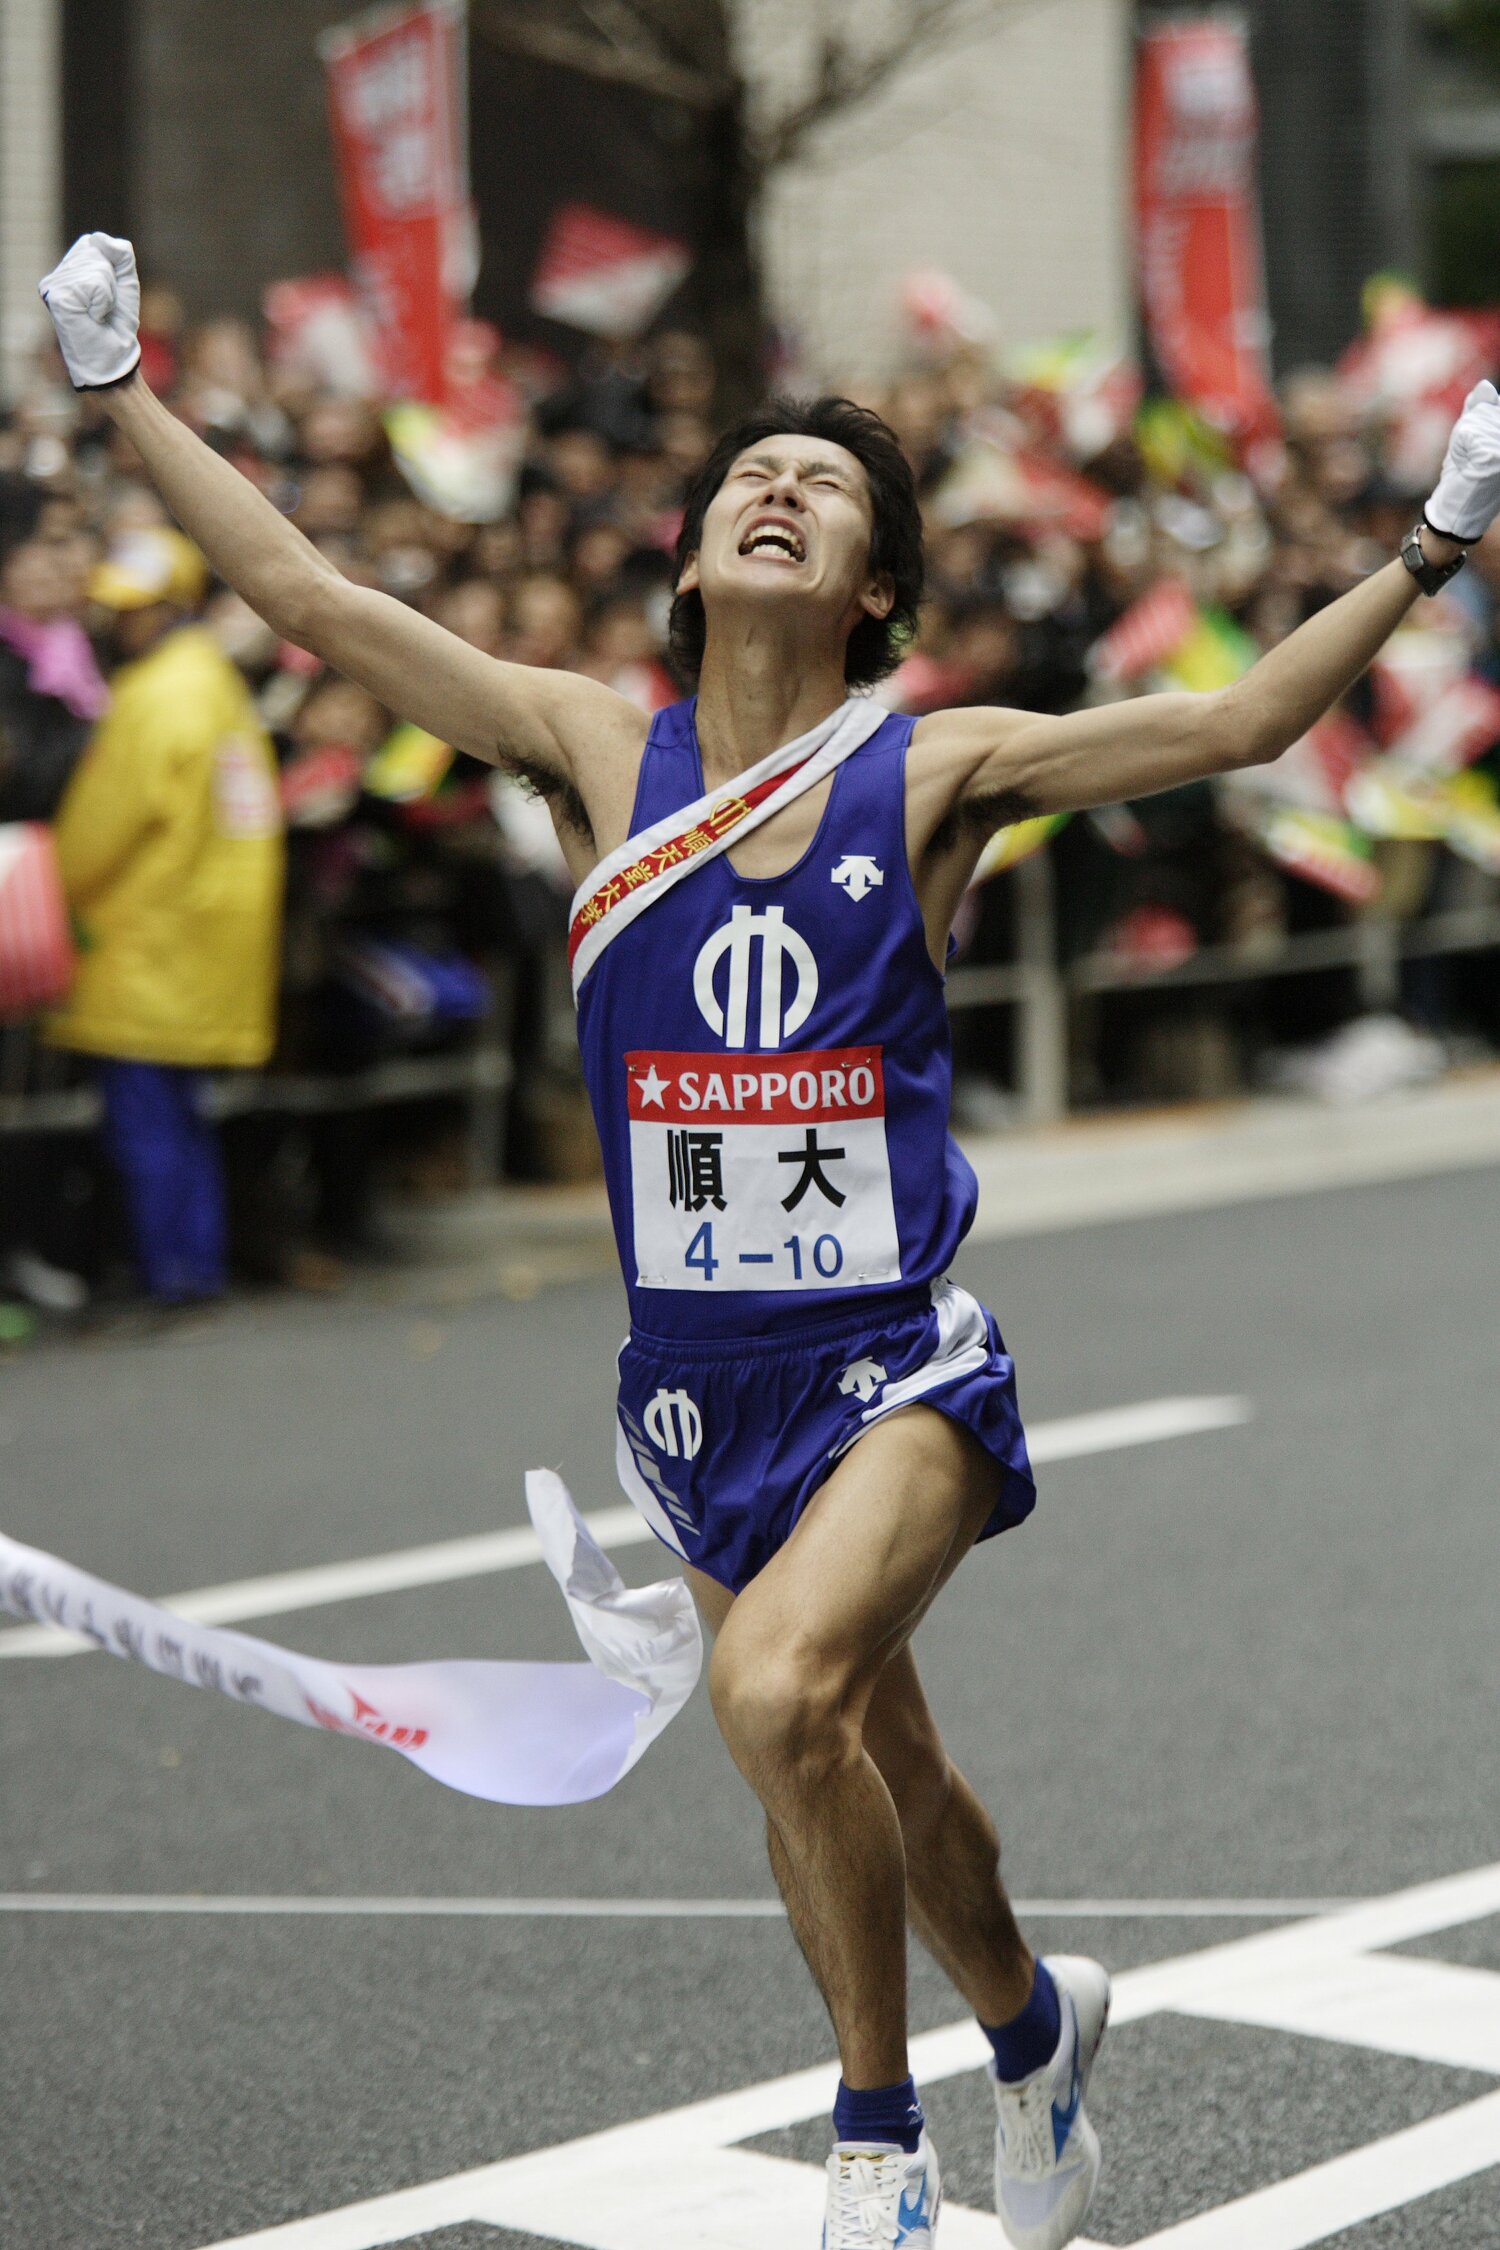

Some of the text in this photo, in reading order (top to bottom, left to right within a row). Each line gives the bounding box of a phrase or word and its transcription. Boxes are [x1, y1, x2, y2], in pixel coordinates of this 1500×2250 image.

[580, 826, 713, 924] 順天堂大学
[678, 1066, 876, 1112] SAPPORO
